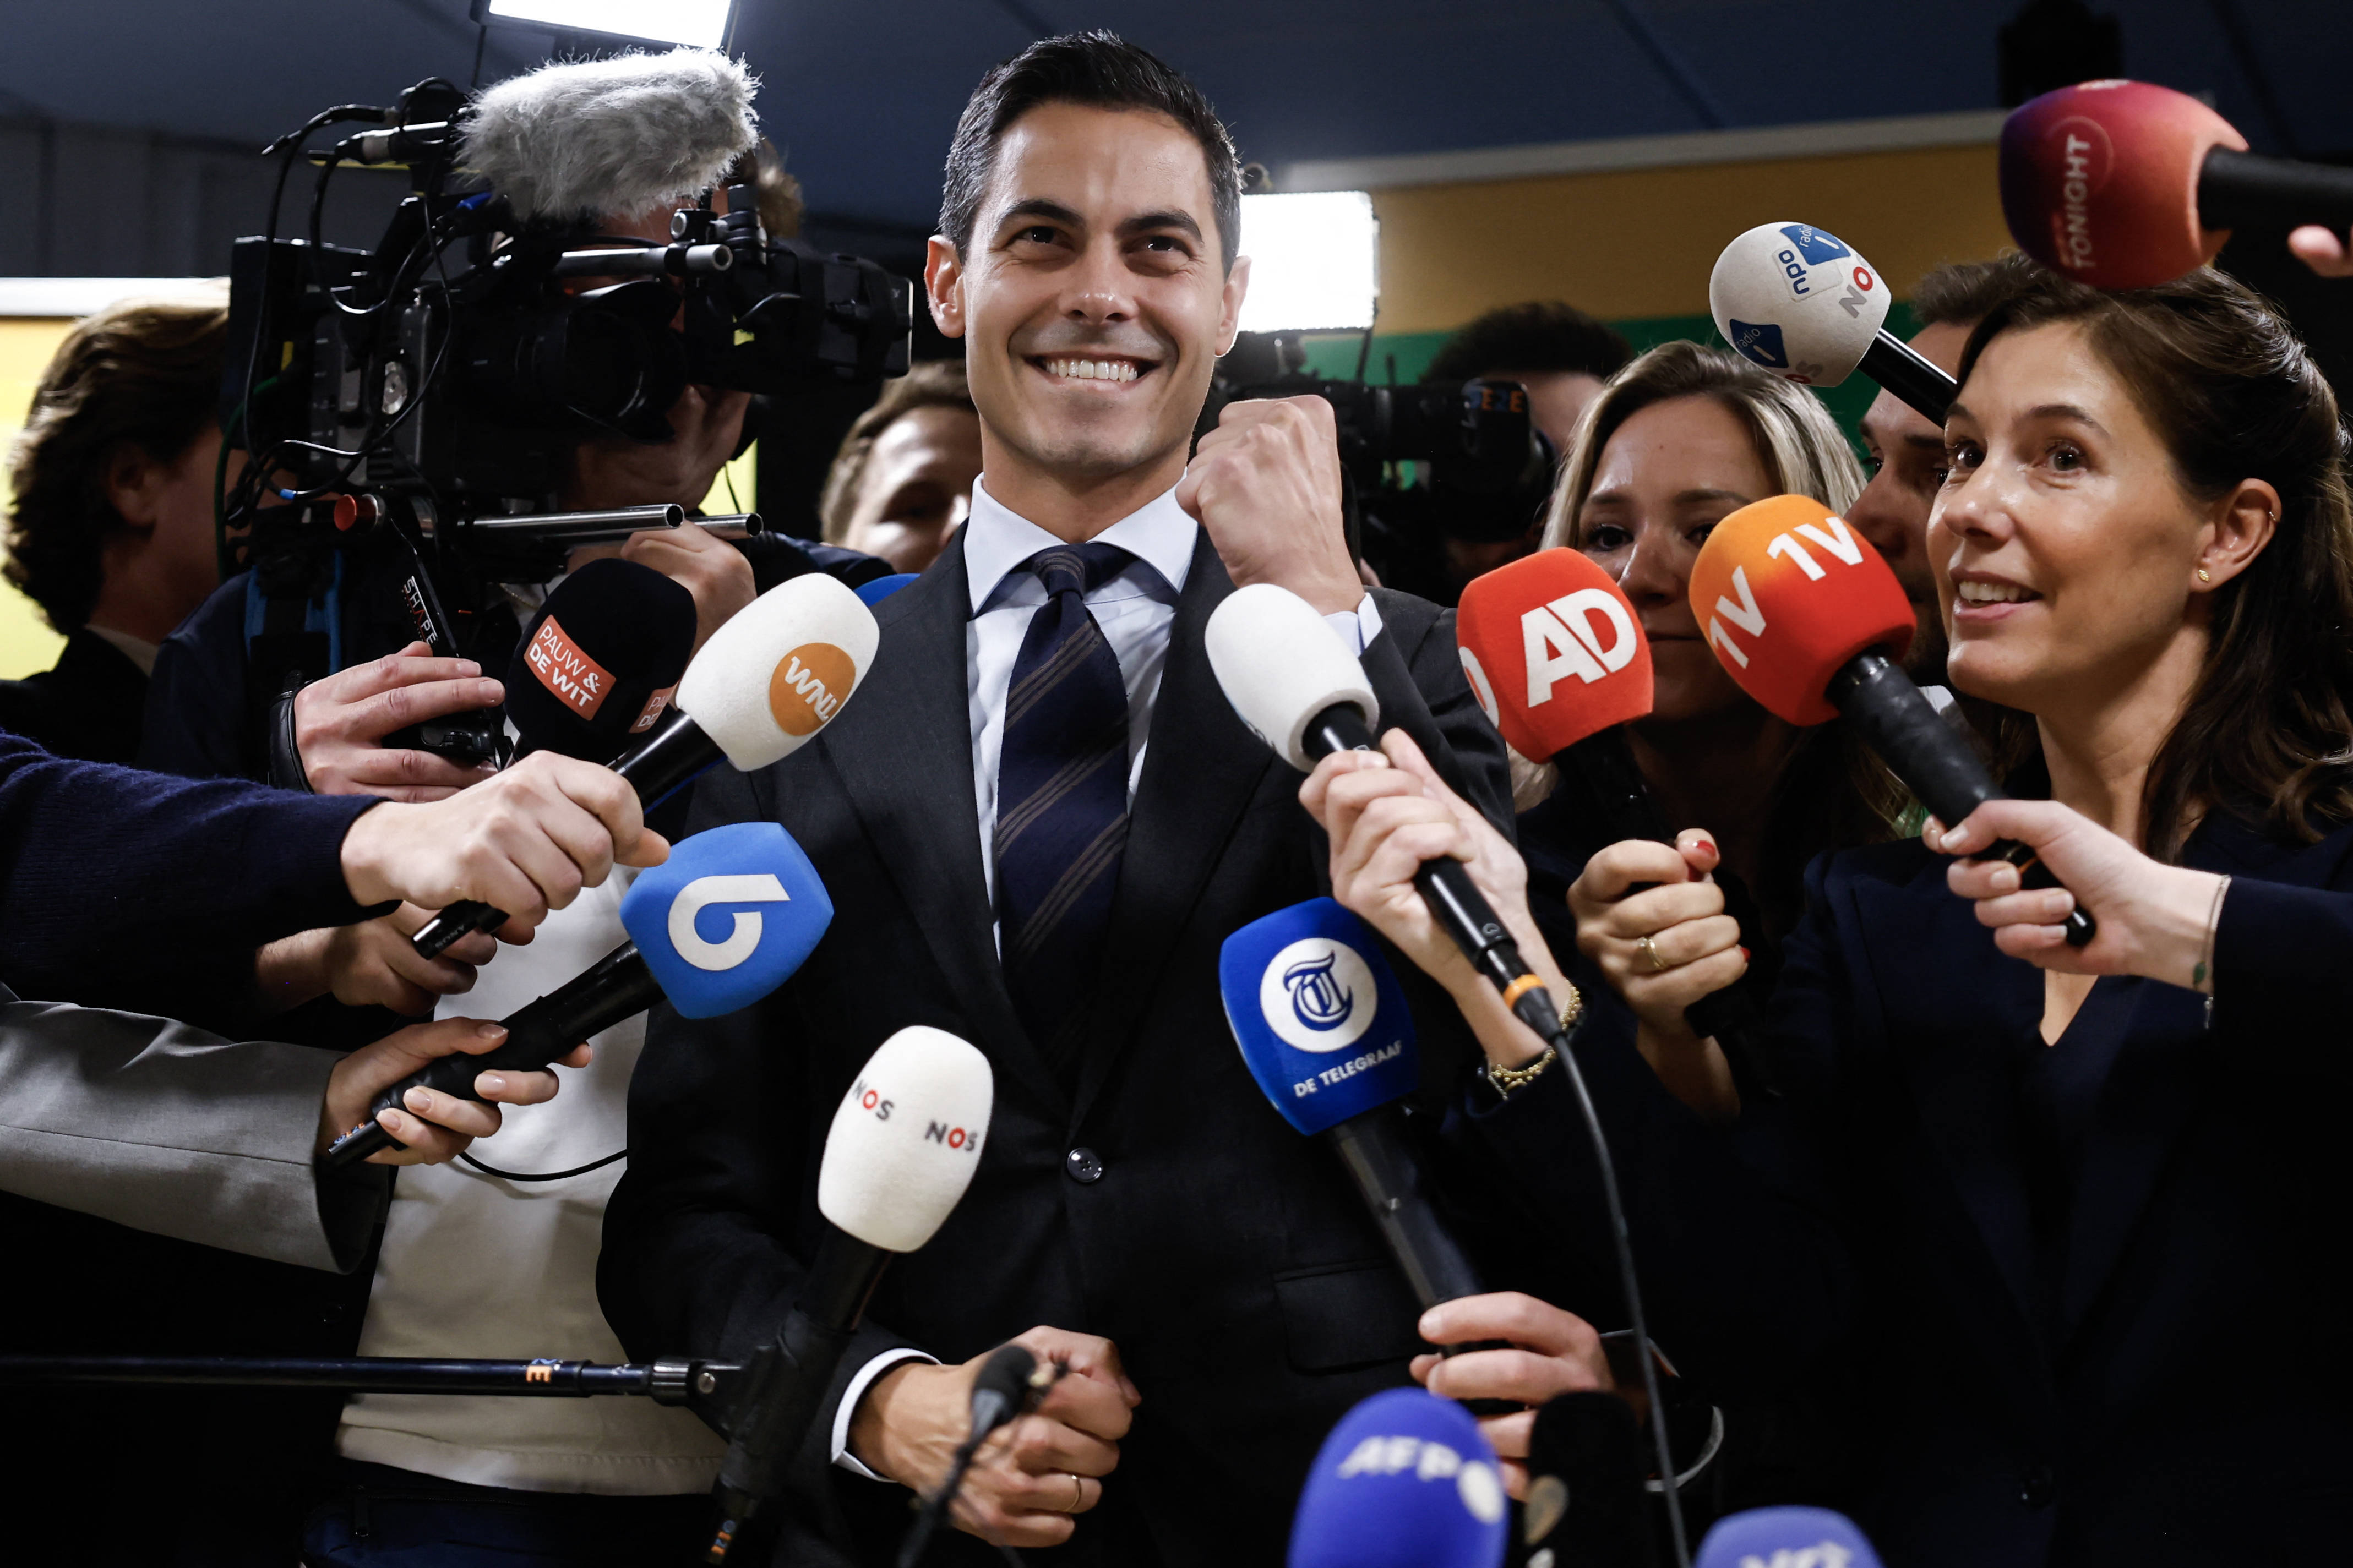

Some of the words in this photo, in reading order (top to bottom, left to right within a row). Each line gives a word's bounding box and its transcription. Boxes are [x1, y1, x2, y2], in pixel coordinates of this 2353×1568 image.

[2065, 134, 2096, 269] TONIGHT
[1798, 225, 1812, 247] radio
[1778, 250, 1810, 294] npo
[1736, 329, 1761, 348] radio
[539, 625, 586, 676] PAUW
[582, 672, 600, 694] &
[1521, 588, 1637, 708] AD
[529, 642, 551, 674] DE
[552, 667, 593, 707] WIT
[1294, 1077, 1317, 1098] DE
[1319, 1040, 1402, 1086] TELEGRAAF
[852, 1079, 895, 1121] NOS
[924, 1119, 978, 1152] NOS
[1337, 1435, 1462, 1482] AFP
